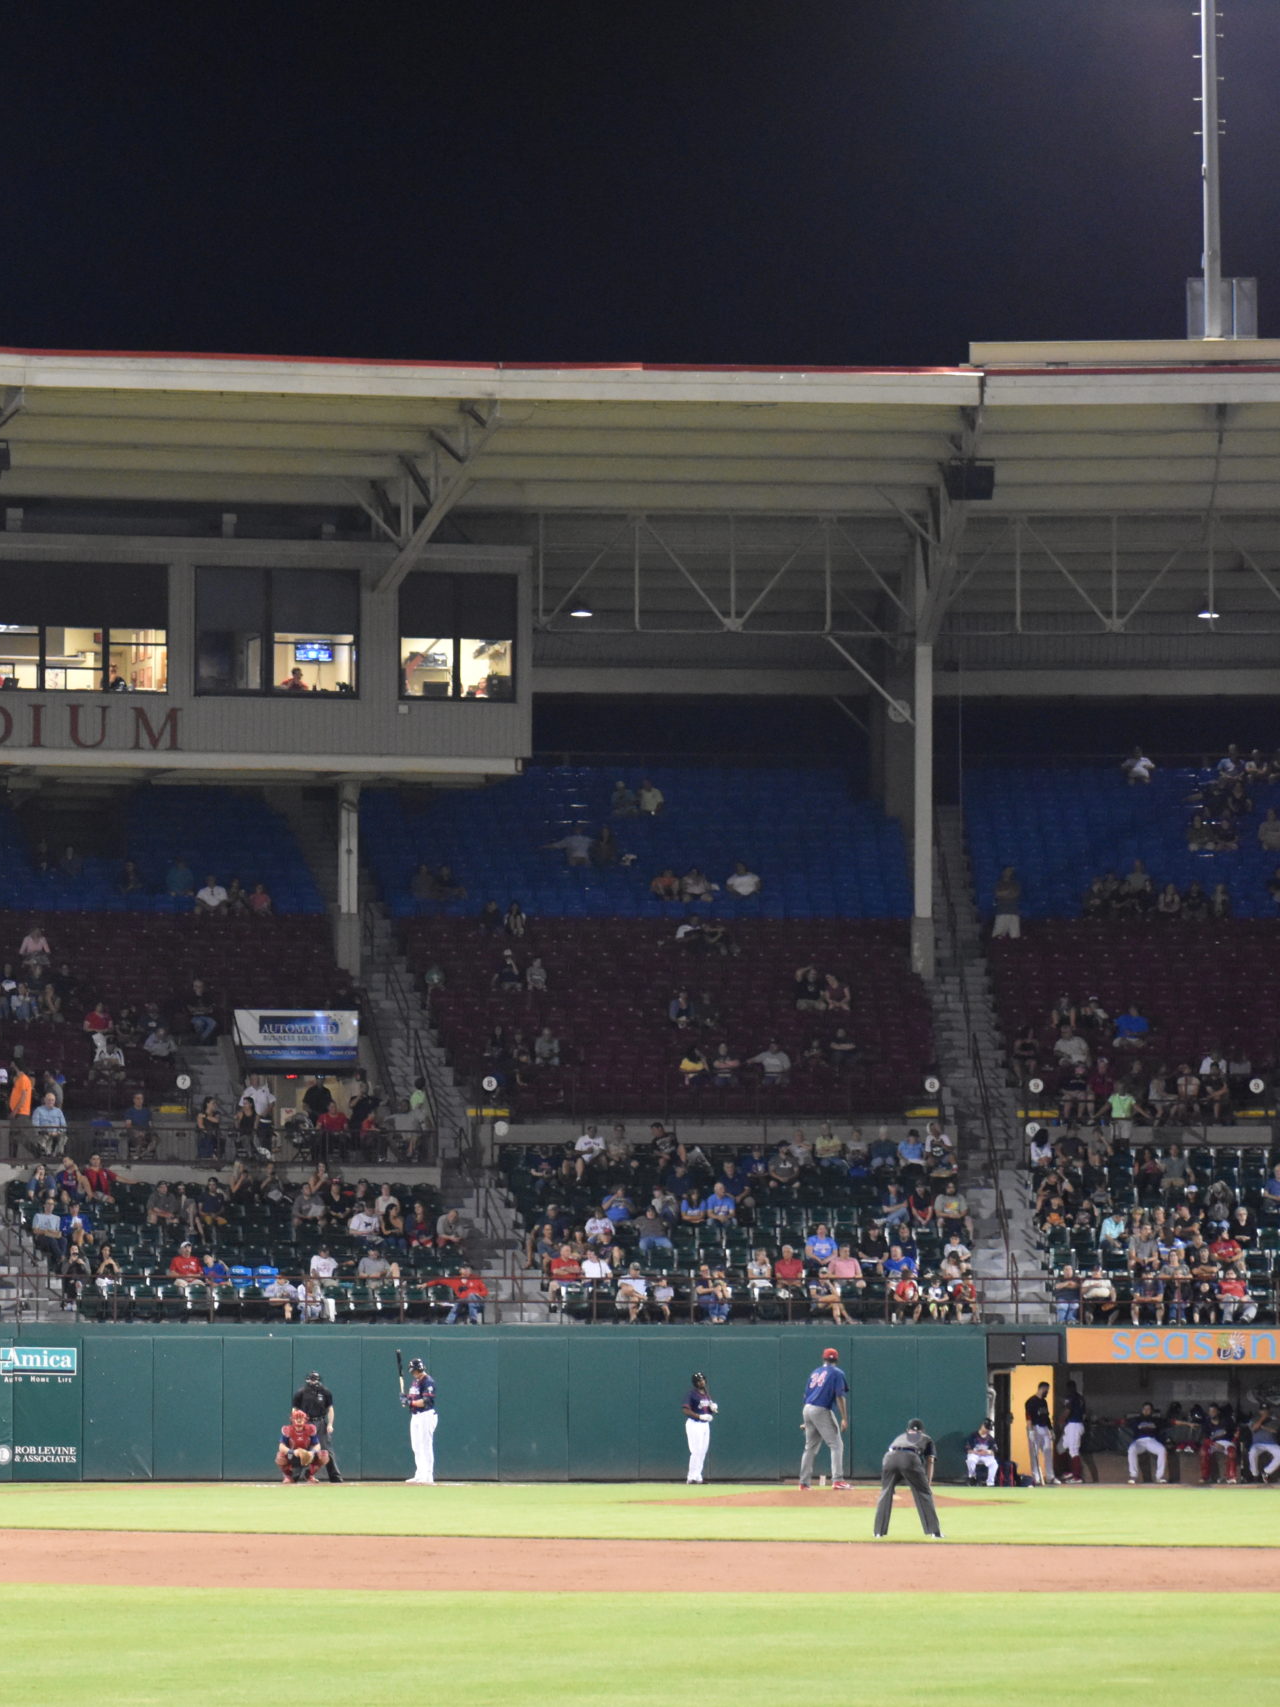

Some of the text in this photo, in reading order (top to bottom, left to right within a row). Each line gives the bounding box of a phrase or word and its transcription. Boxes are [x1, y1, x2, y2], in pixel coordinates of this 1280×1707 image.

[262, 1023, 337, 1034] AUTOMATED
[15, 1445, 77, 1455] ROB LEVINE
